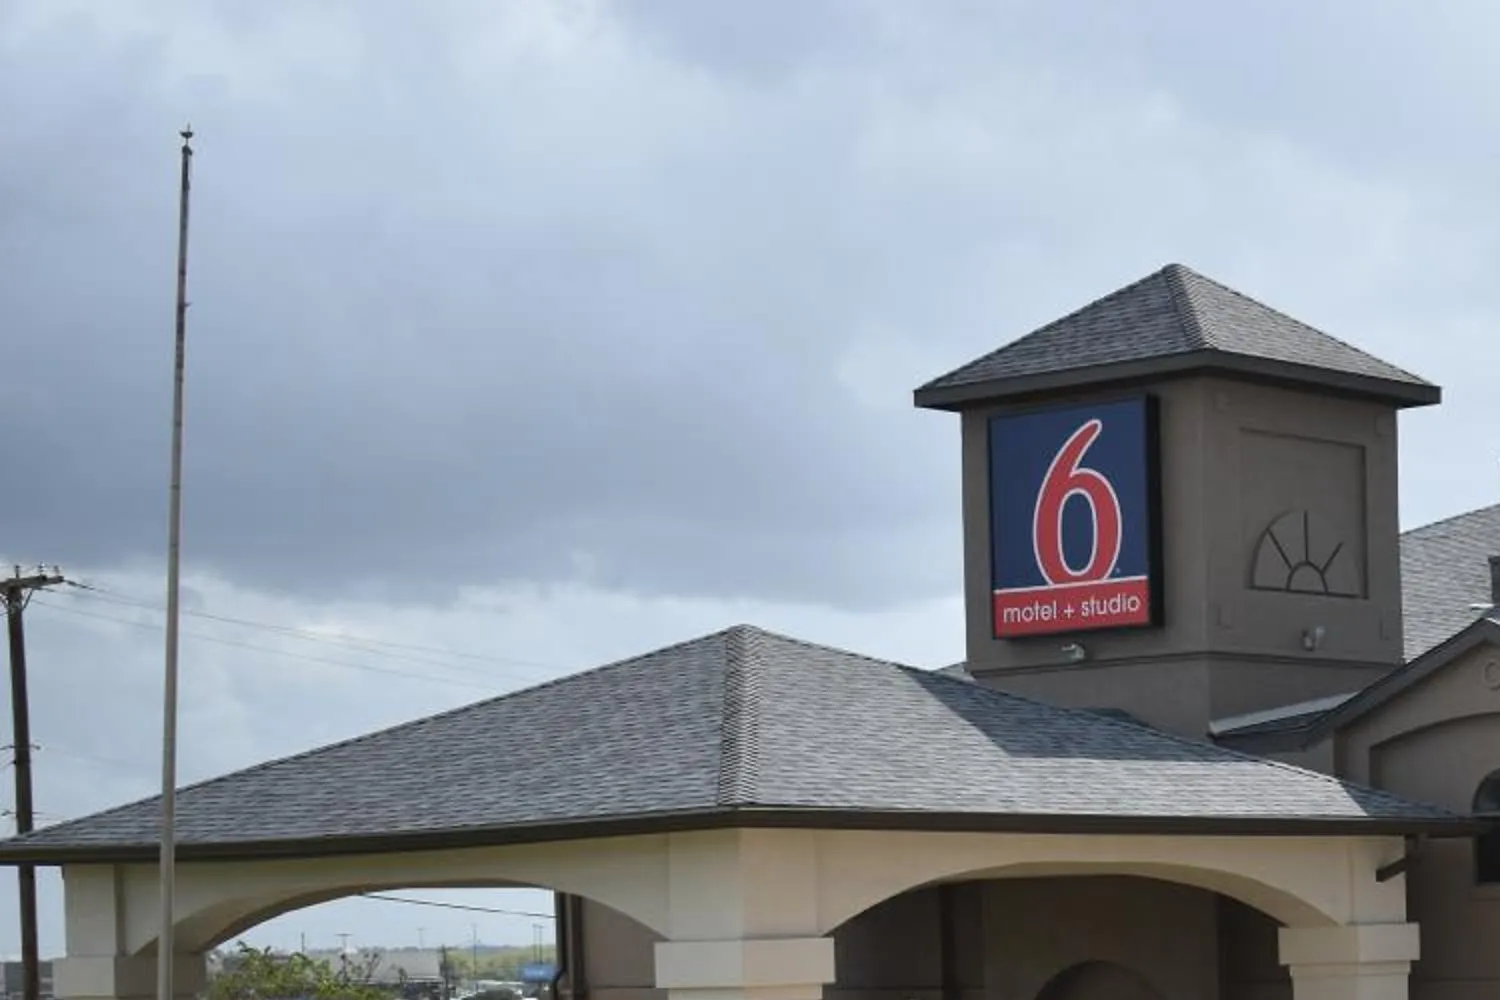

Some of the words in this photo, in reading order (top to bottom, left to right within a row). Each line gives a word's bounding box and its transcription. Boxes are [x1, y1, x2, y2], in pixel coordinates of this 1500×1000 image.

[1033, 418, 1122, 587] 6
[1003, 600, 1057, 623] motel
[1081, 593, 1141, 617] studio
